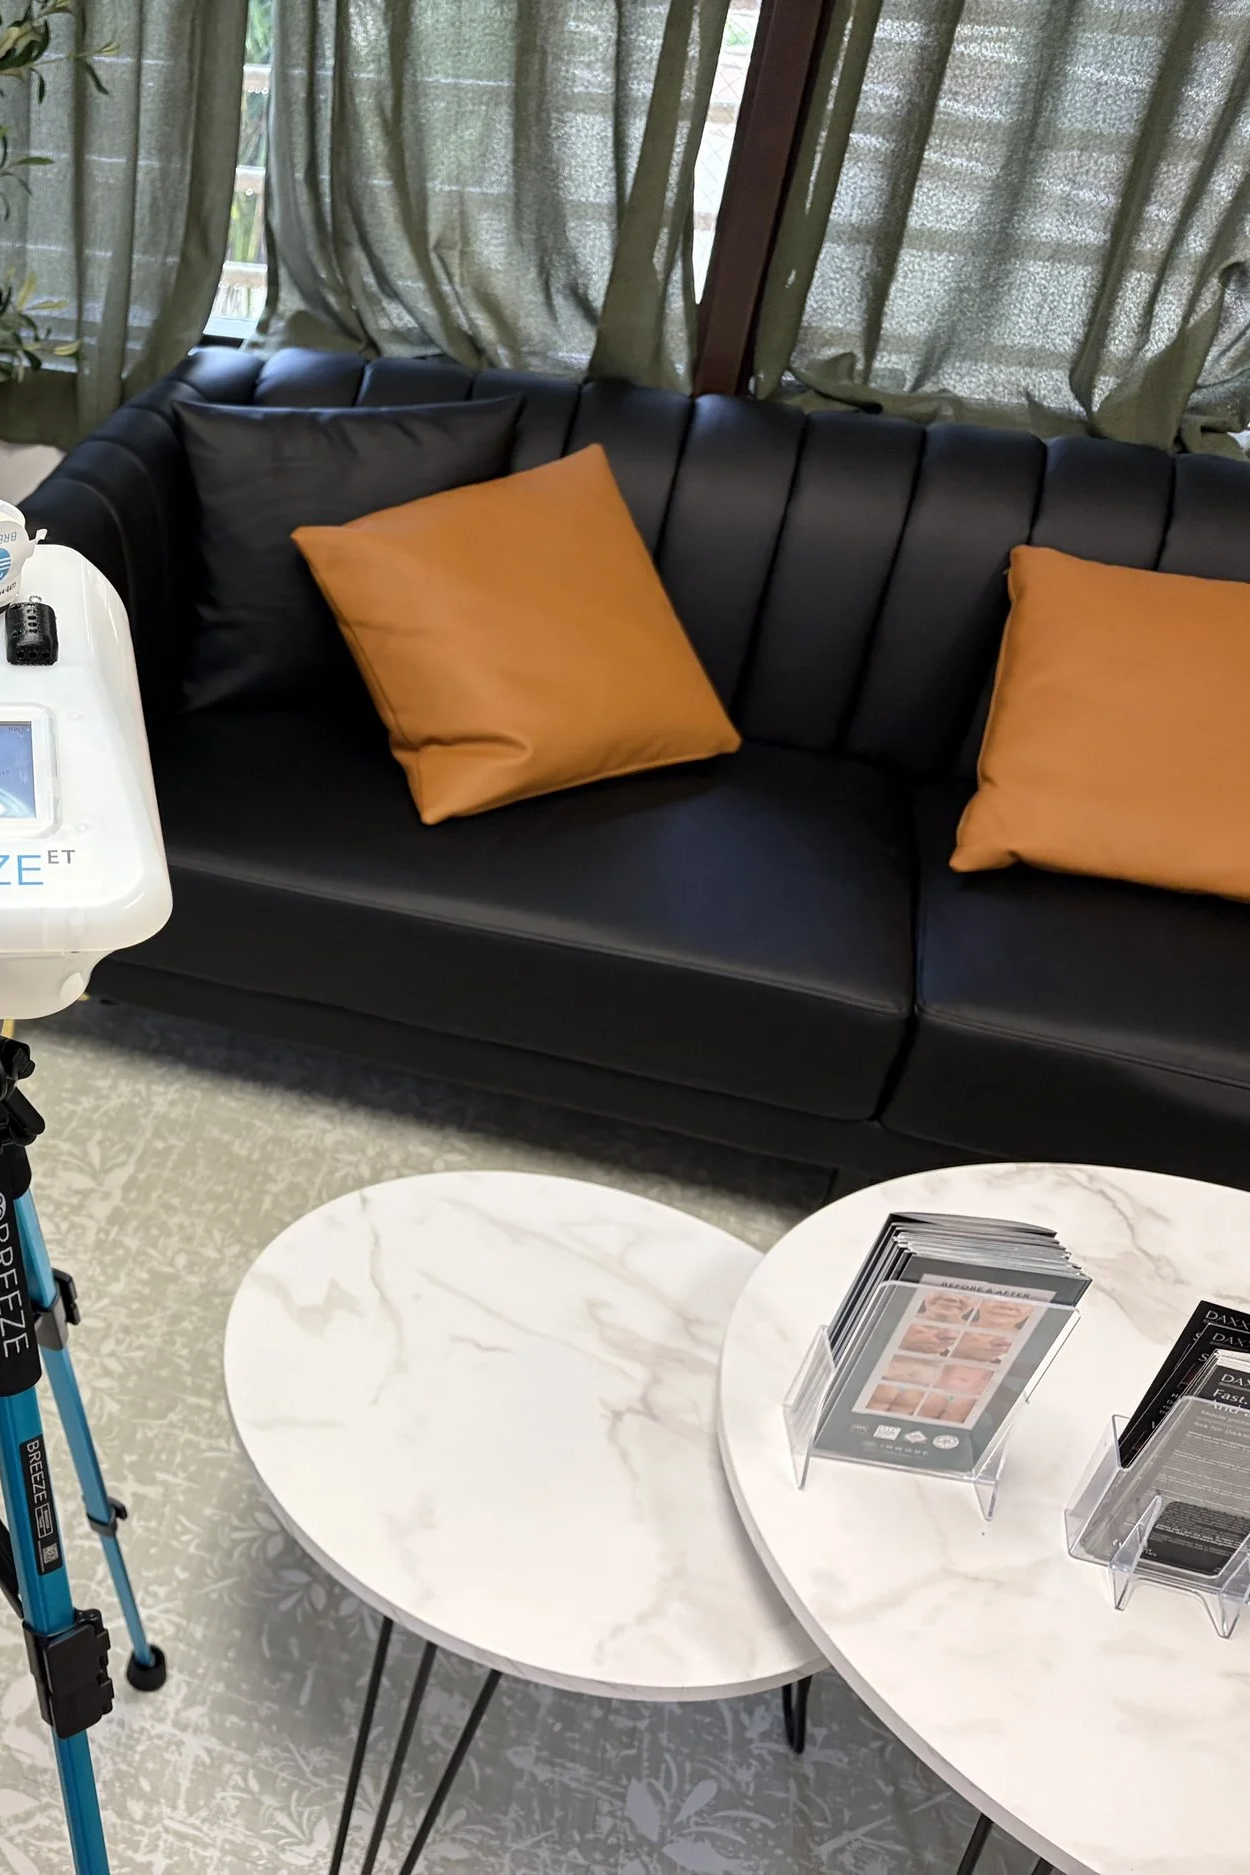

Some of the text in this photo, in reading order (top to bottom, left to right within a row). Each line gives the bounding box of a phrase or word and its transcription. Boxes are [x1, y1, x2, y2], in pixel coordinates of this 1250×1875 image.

[47, 849, 76, 864] ET
[940, 1281, 982, 1293] BEFORE
[994, 1289, 1031, 1299] AFTER
[1212, 1332, 1250, 1348] DAX
[1213, 1389, 1248, 1405] Fast.
[26, 1440, 47, 1504] BREEZE
